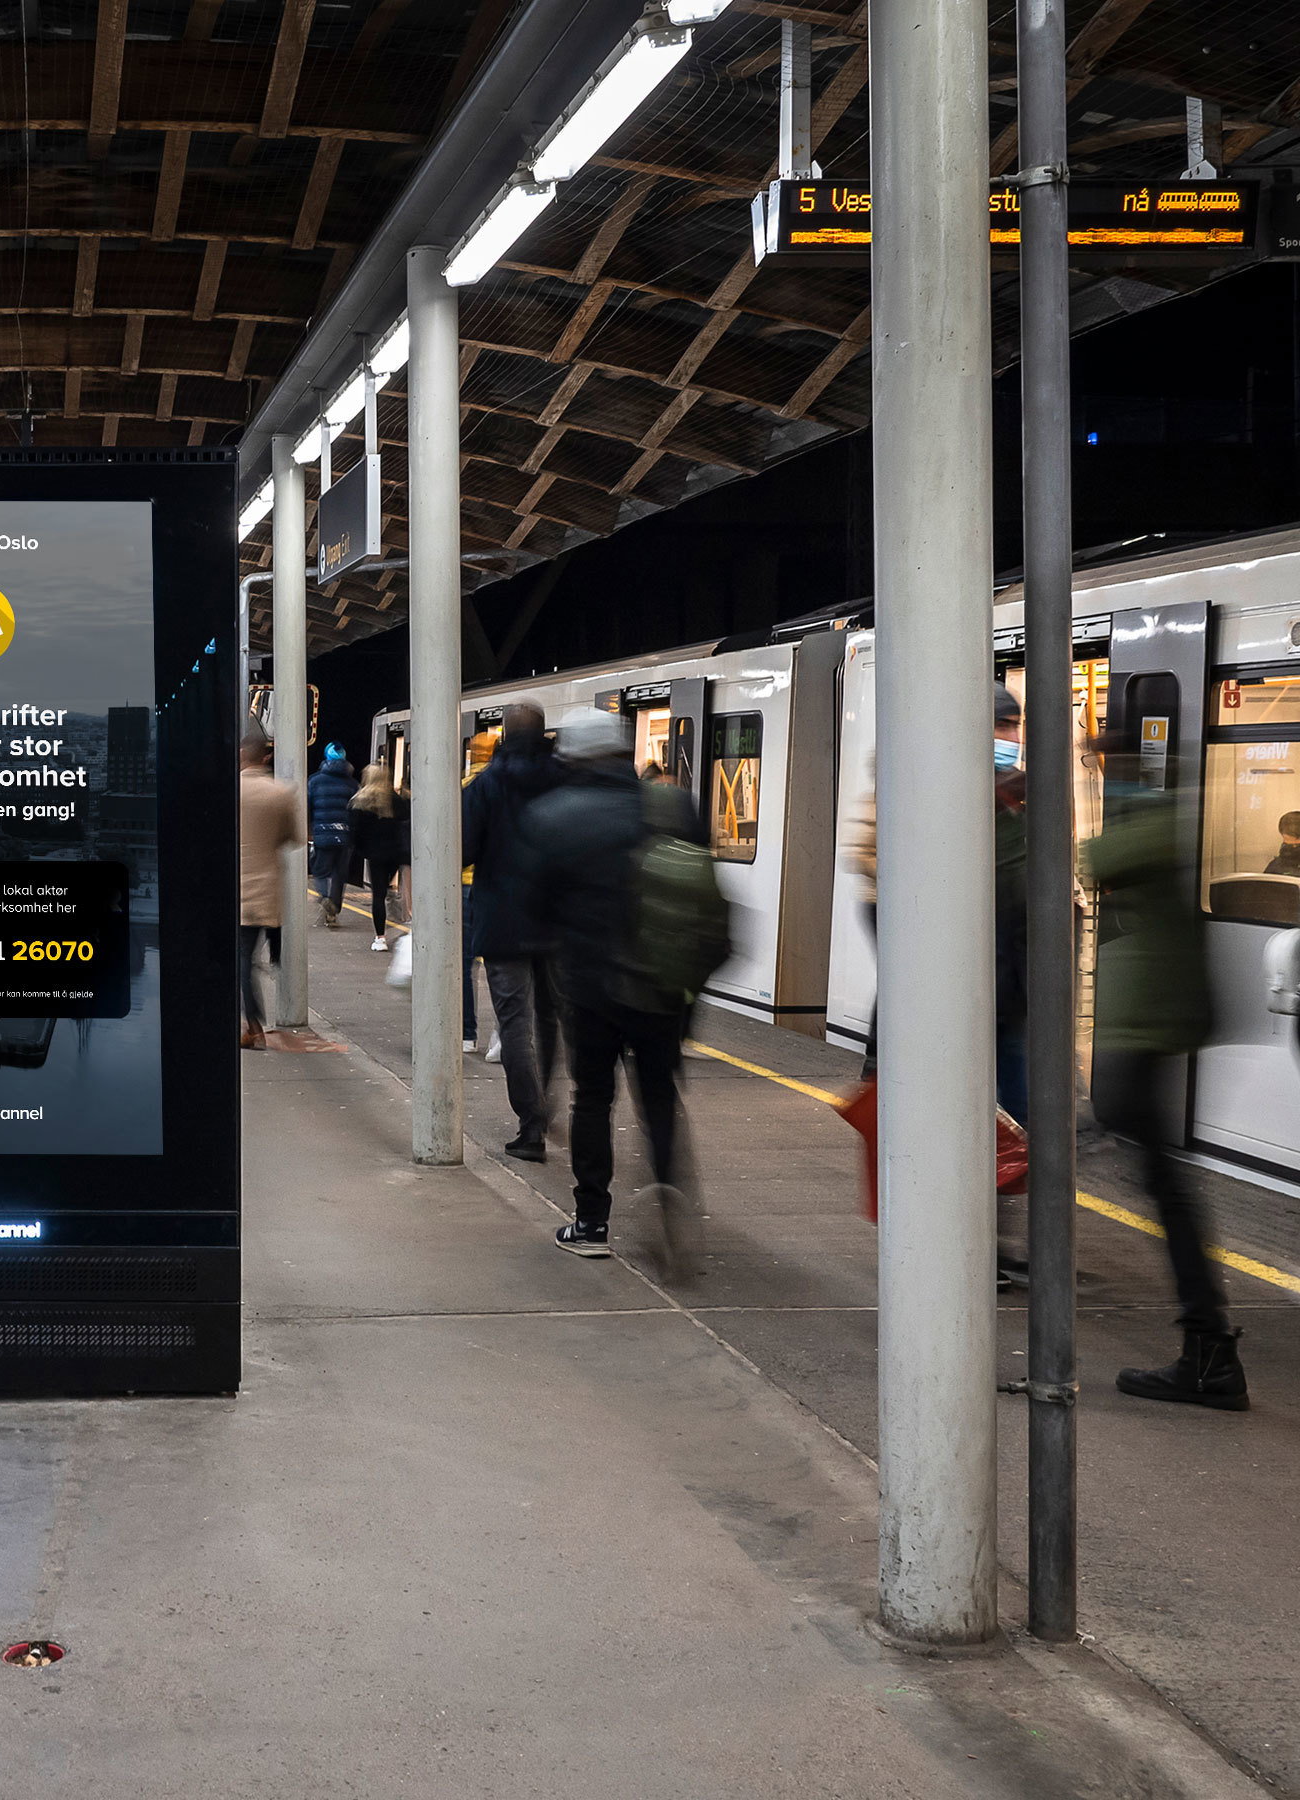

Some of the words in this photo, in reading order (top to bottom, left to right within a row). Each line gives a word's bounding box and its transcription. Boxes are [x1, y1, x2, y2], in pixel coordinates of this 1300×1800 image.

[799, 187, 816, 213] 5
[1123, 187, 1150, 212] nå
[9, 735, 63, 757] stor
[22, 802, 76, 821] gang!
[3, 884, 34, 896] lokal
[36, 884, 69, 897] aktør
[56, 902, 77, 914] her
[12, 940, 94, 962] 26070
[6, 990, 21, 998] kan
[22, 990, 51, 998] komme
[52, 990, 61, 998] til
[61, 990, 68, 998] å
[69, 990, 94, 1000] gjelde
